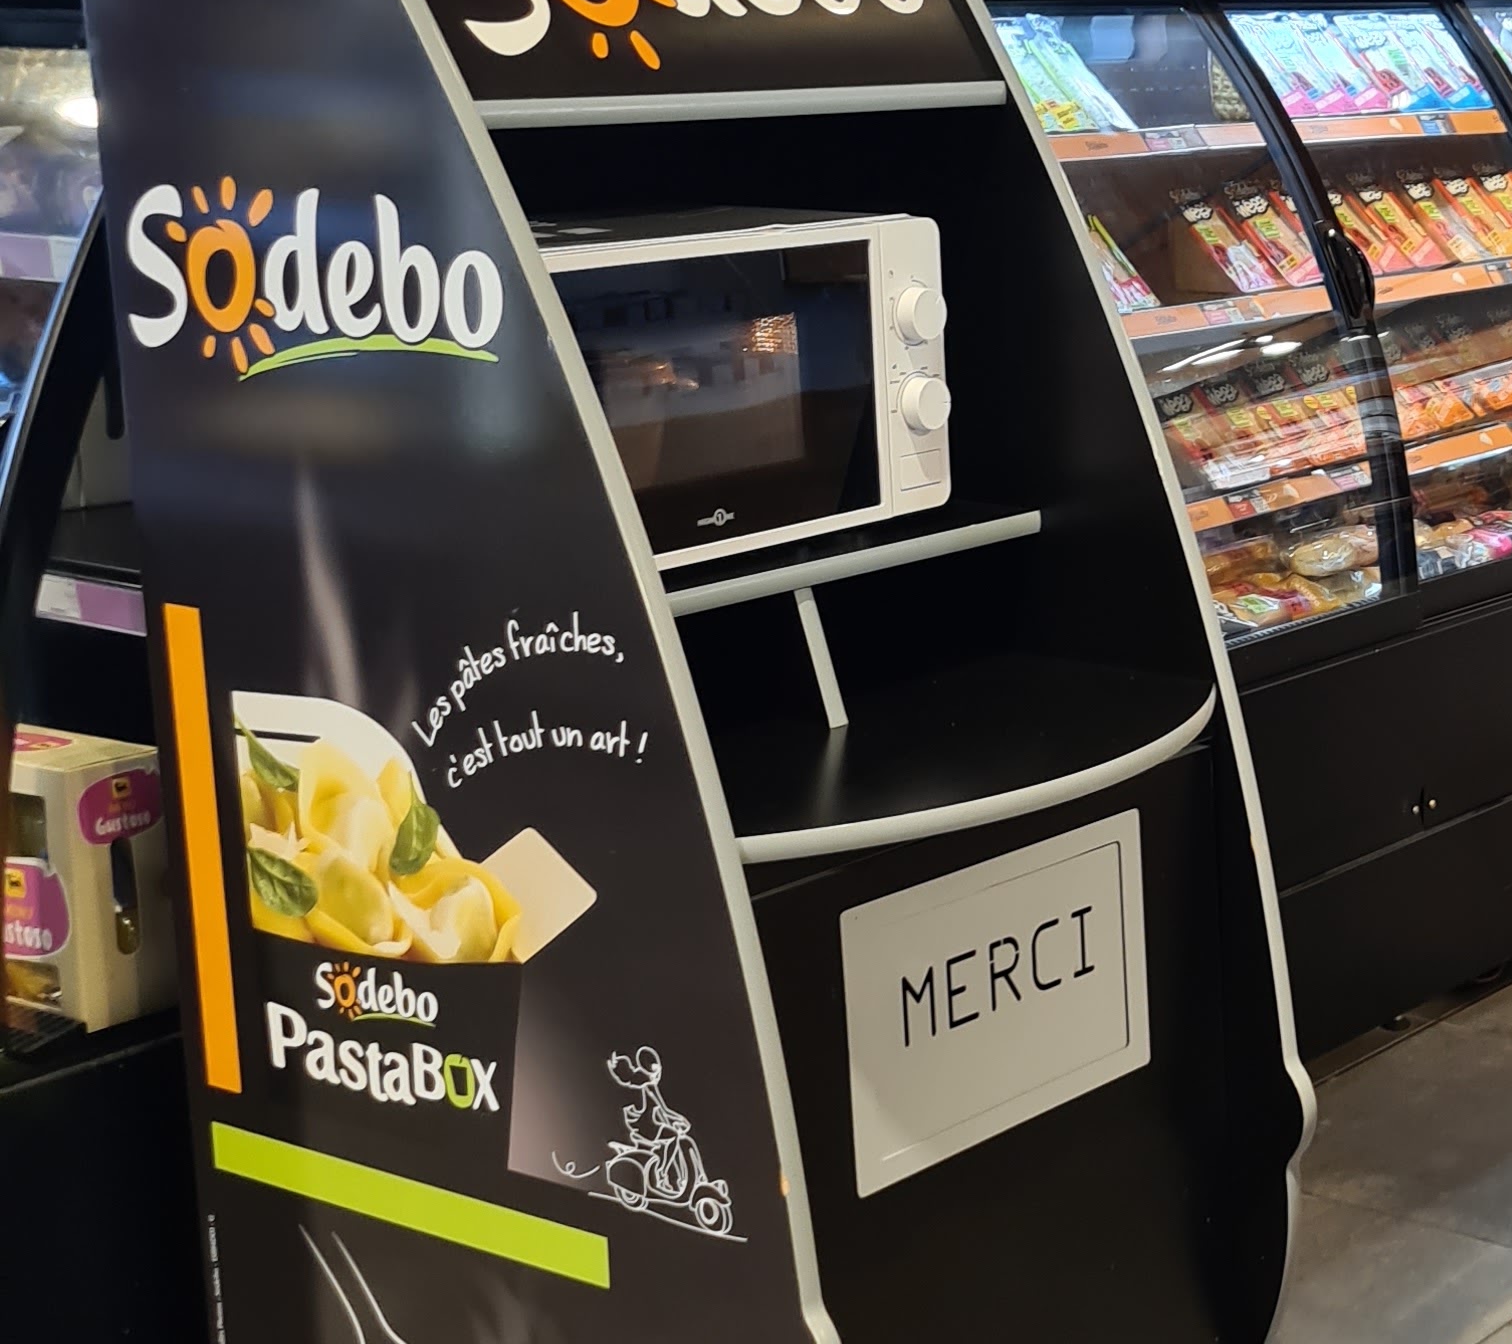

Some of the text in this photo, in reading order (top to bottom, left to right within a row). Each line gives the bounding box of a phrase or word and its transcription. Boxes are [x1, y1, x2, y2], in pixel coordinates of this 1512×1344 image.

[126, 177, 505, 368] Sodebo
[411, 610, 625, 747] Les pâtes fraîches,
[447, 727, 494, 788] c'est
[493, 709, 546, 757] tout
[551, 725, 584, 748] un
[590, 719, 631, 758] art
[314, 961, 439, 1023] Sodebo
[901, 905, 1096, 1048] MERCI
